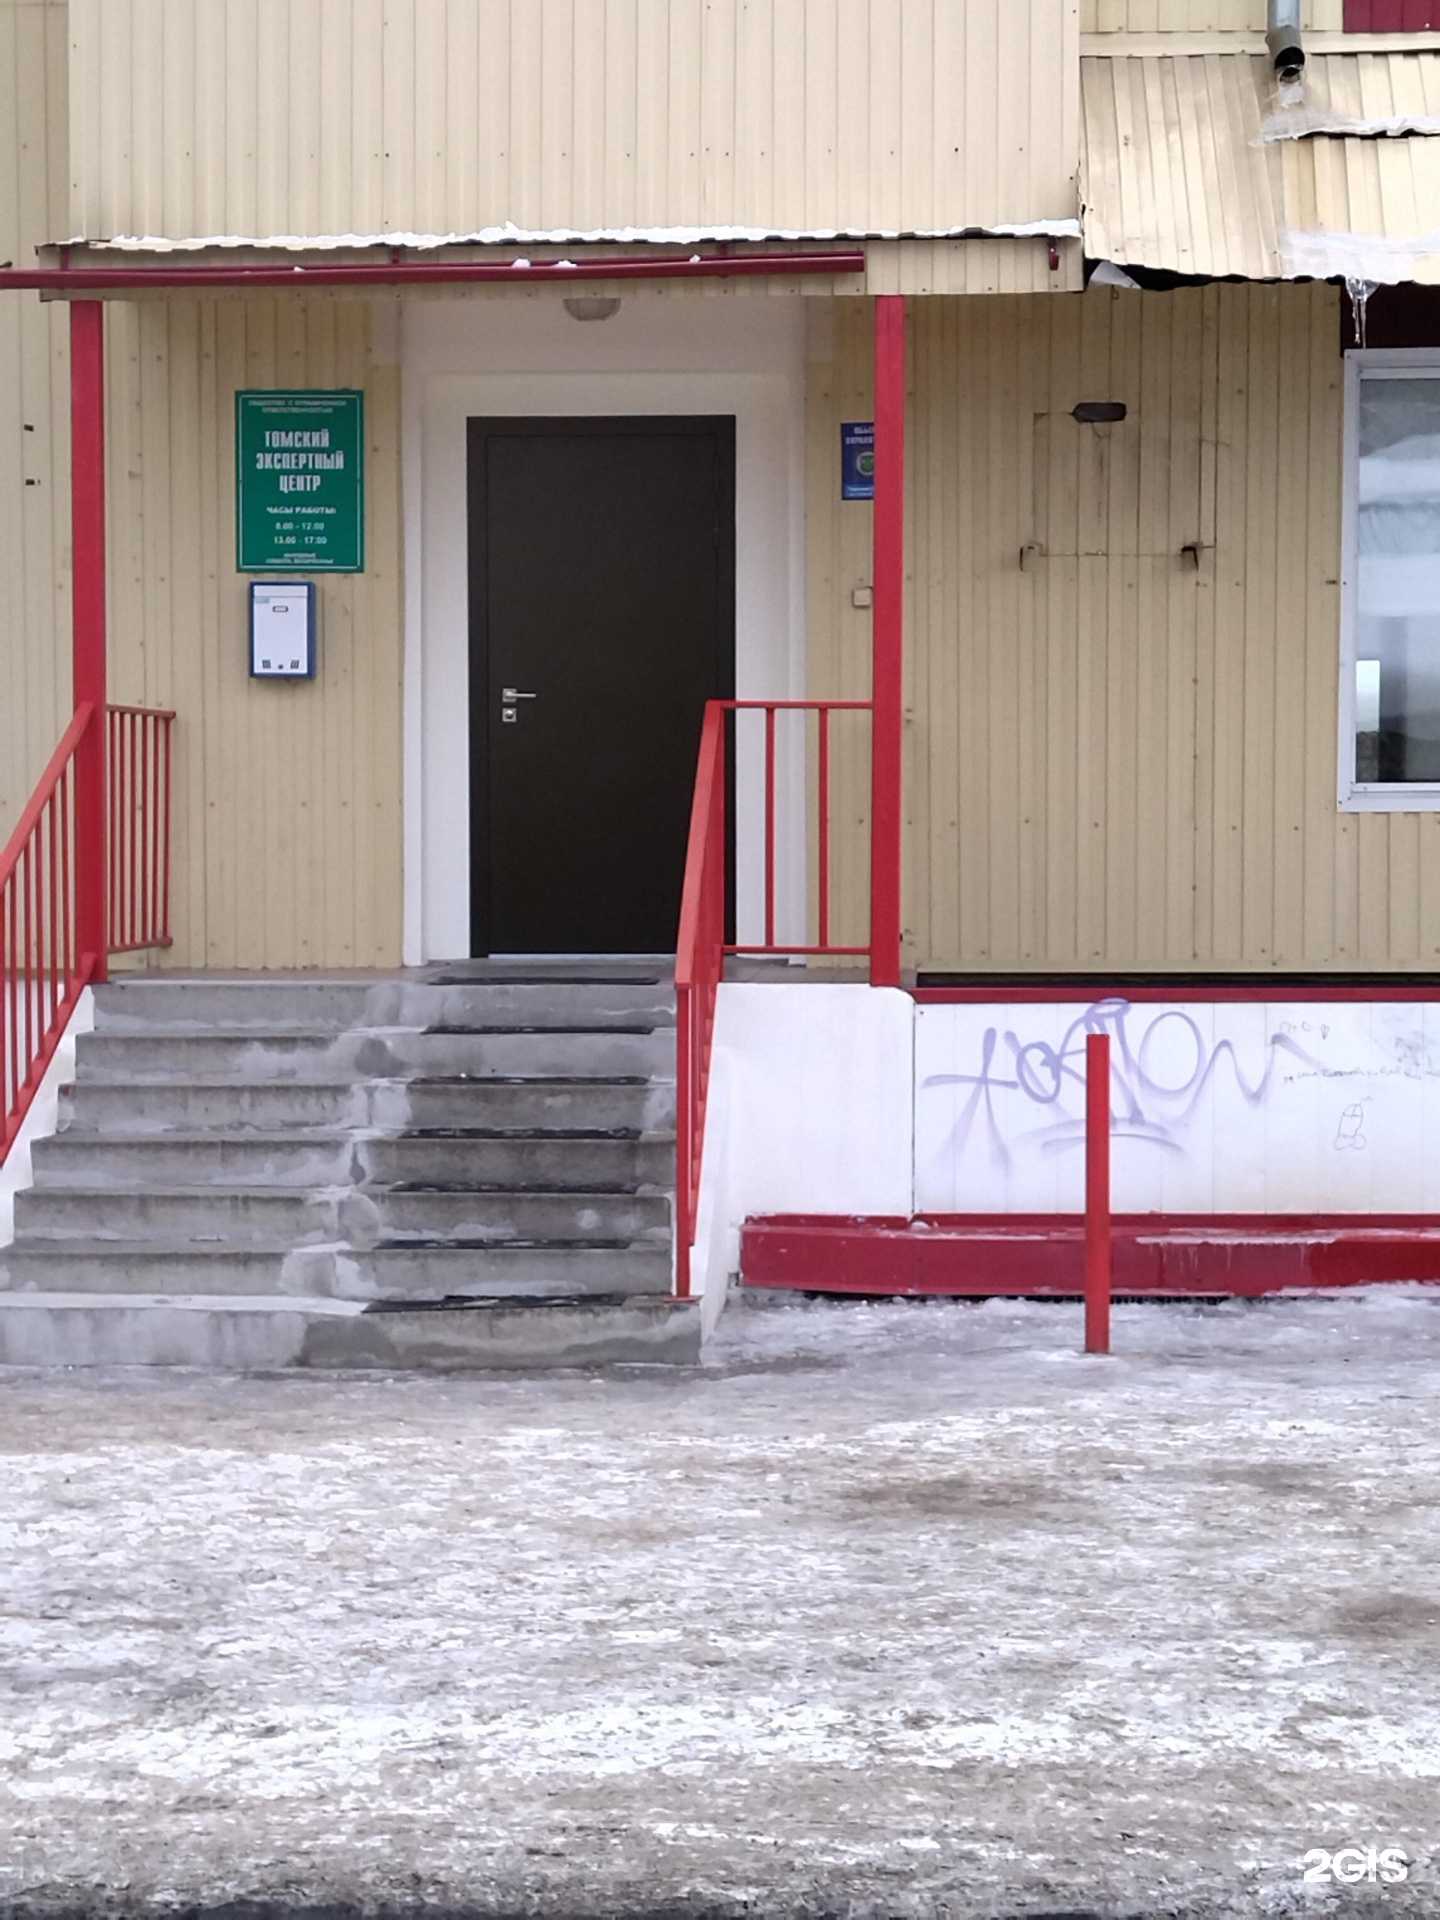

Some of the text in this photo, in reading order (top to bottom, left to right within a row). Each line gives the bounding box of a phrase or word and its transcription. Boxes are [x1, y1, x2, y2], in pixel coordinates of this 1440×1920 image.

[264, 428, 330, 448] ТОМСКИЙ
[255, 450, 344, 470] ЭКСПЕРТНЫЙ
[279, 474, 321, 494] ЦЕНТР
[266, 506, 293, 514] ЧАСЫ
